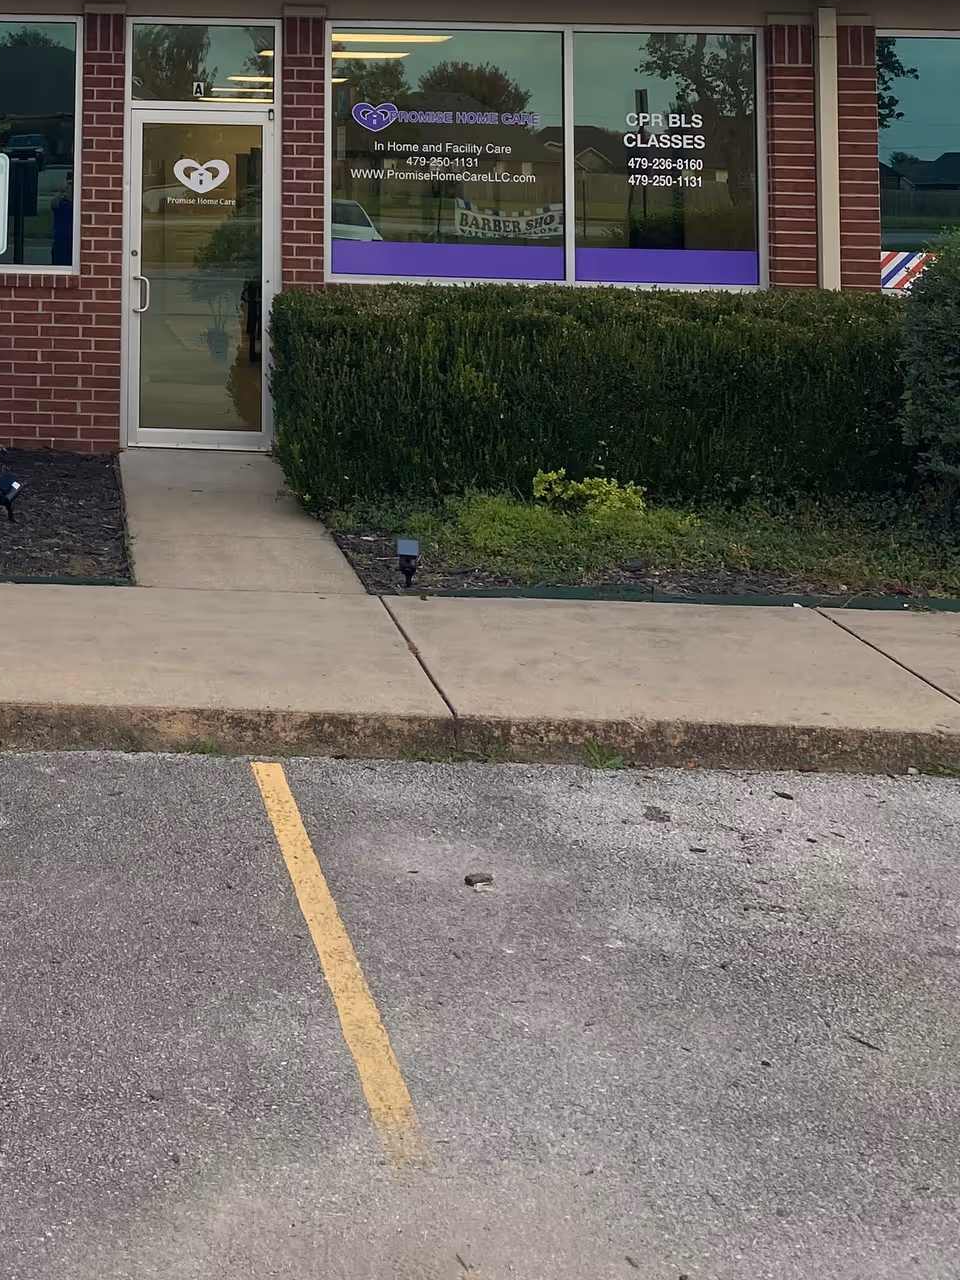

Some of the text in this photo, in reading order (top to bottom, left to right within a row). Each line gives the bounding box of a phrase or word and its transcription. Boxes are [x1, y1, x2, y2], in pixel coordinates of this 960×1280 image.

[193, 83, 203, 96] A
[389, 110, 540, 126] PROMISE HOME CARE
[625, 112, 703, 128] CPR BLS
[374, 141, 512, 155] In Home and Facility Care
[623, 133, 706, 149] CLASSES
[406, 156, 479, 168] 479-250-1131
[627, 157, 703, 171] 479-236-8160
[350, 168, 536, 183] WWW.PromiseHomeCareLLC.com
[627, 174, 702, 188] 479-250-1131
[167, 196, 237, 206] Promise Home Care
[459, 212, 522, 234] BARBER
